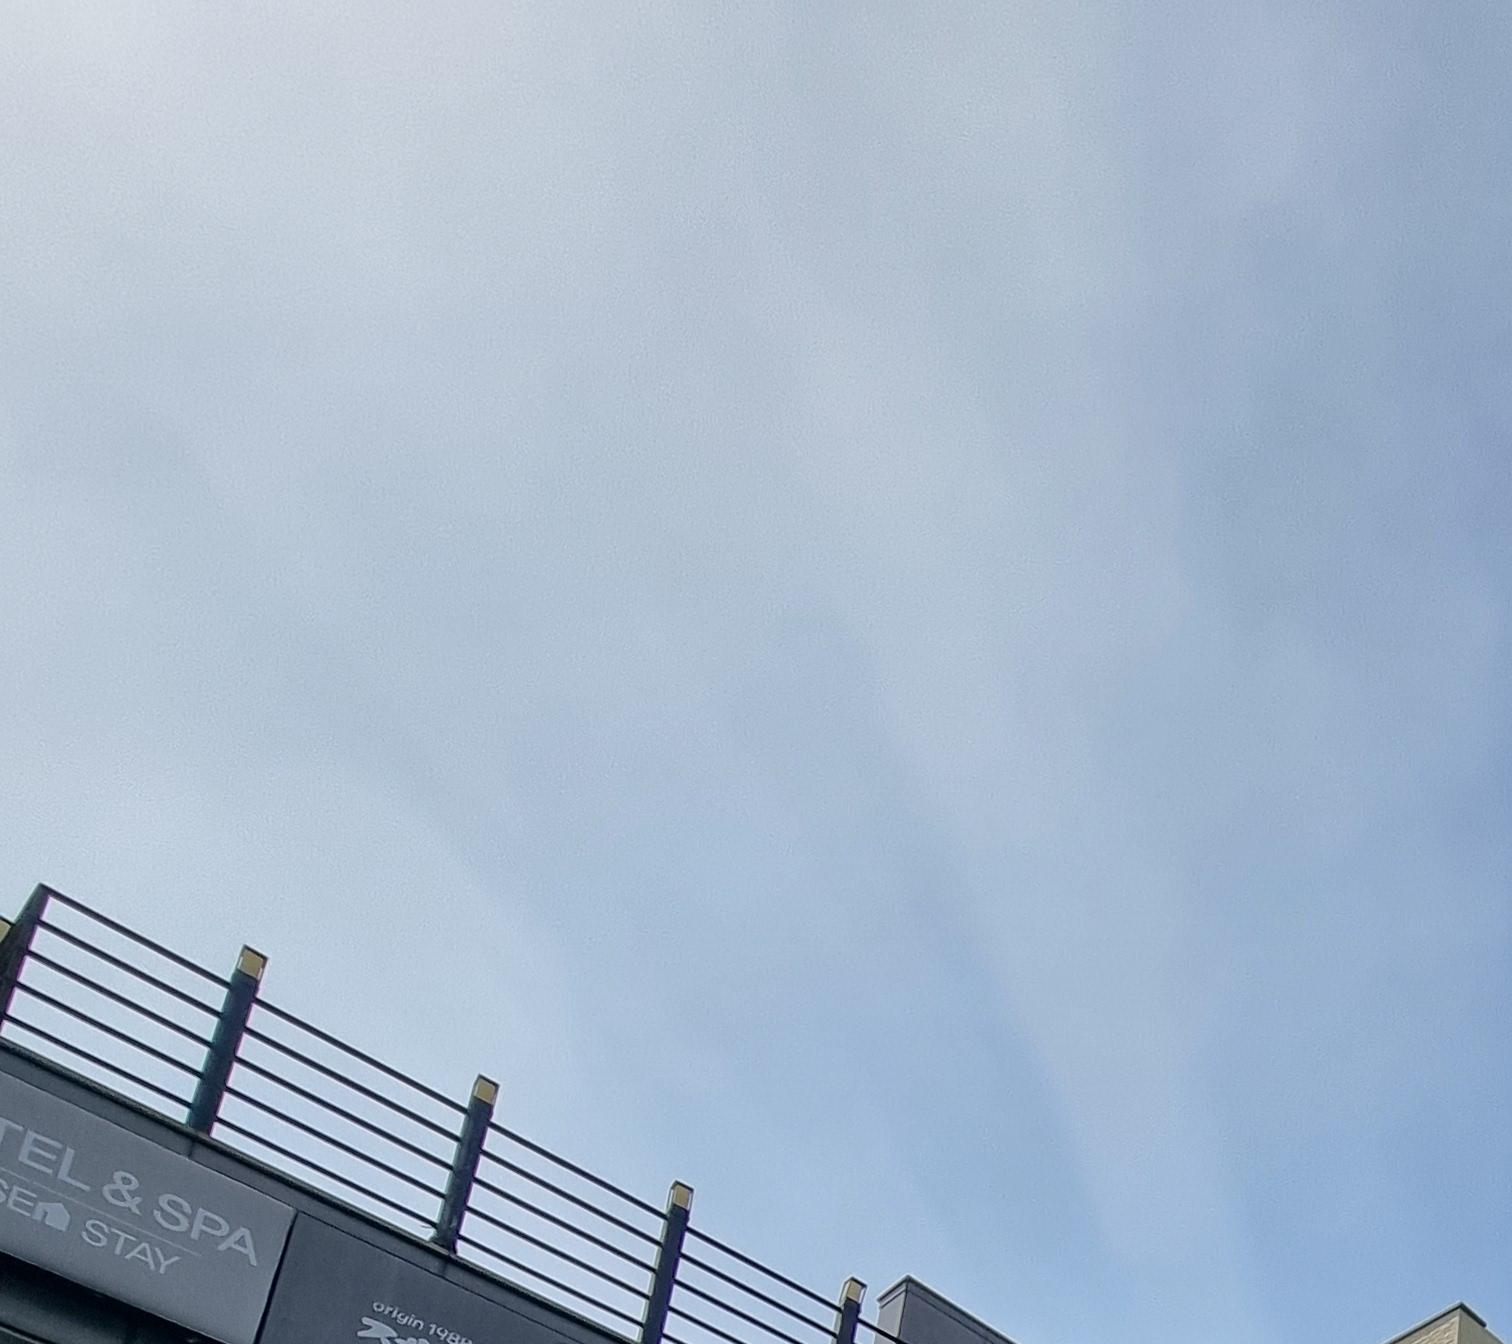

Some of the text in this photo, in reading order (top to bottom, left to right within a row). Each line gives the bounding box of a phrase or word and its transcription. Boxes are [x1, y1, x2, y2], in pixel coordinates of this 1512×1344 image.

[102, 1170, 142, 1216] &
[153, 1193, 258, 1267] SPA
[81, 1219, 181, 1275] STAY
[372, 1301, 424, 1331] origin
